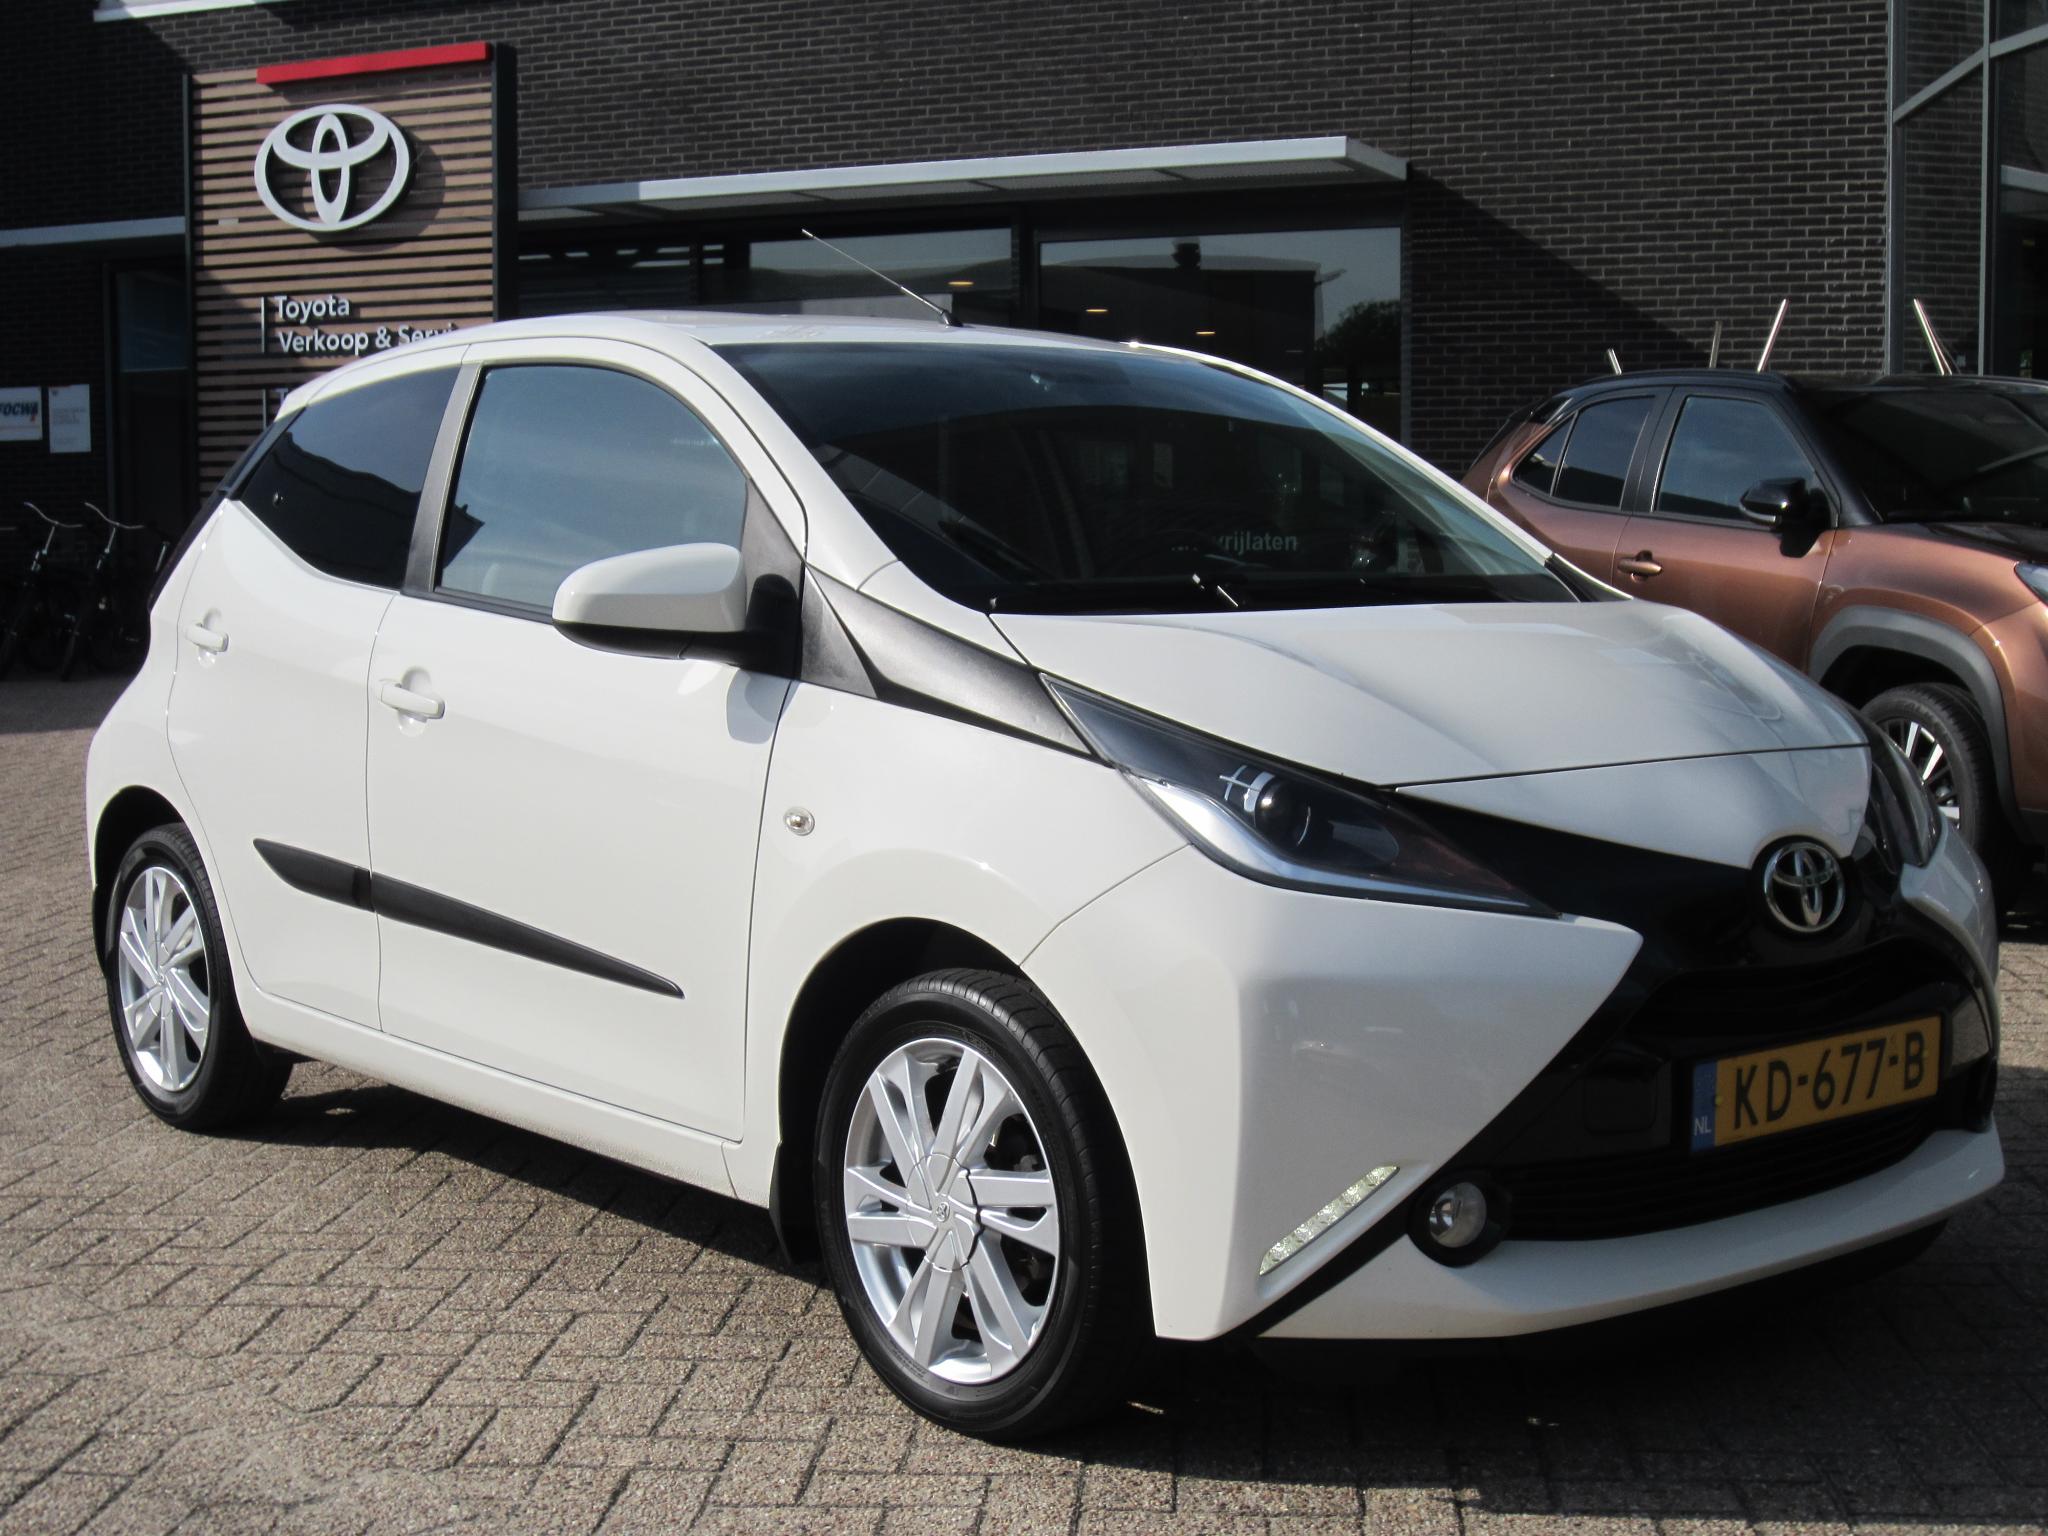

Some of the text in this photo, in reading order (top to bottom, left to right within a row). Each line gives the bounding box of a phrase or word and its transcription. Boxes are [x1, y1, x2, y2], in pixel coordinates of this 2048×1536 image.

[275, 295, 350, 323] Toyota
[279, 329, 369, 355] Verkoop
[375, 325, 391, 347] &
[1734, 1030, 1925, 1129] KD-677-B
[1693, 1116, 1712, 1137] NL
